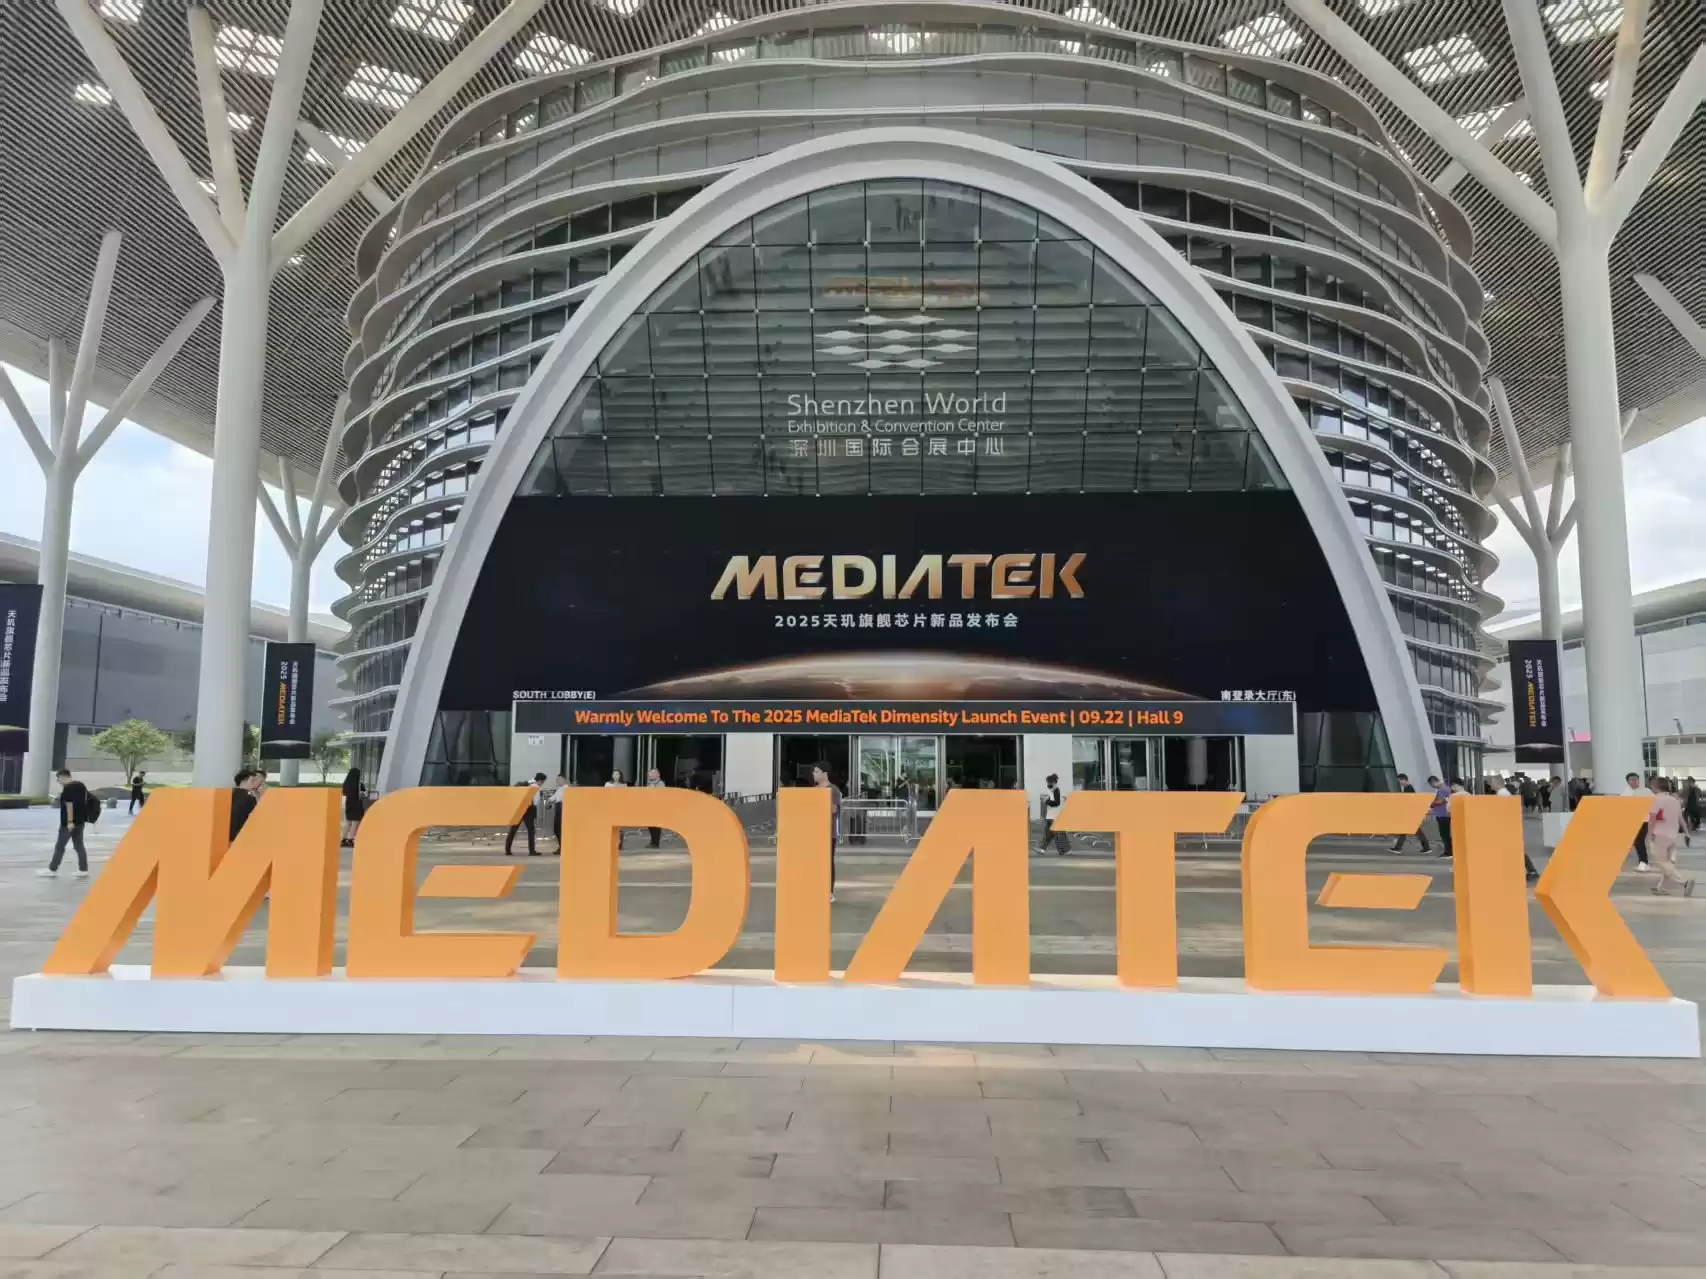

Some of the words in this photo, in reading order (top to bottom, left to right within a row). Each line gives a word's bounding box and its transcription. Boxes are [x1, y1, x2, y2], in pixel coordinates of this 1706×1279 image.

[787, 393, 914, 416] Shenzhen
[924, 391, 1007, 415] World
[787, 419, 857, 433] Exhibition
[860, 419, 870, 433] &
[874, 418, 955, 433] Convention
[957, 418, 1005, 432] Center
[788, 436, 1005, 457] 深圳国际会展中心
[710, 552, 1087, 601] MEDIATEK
[280, 660, 288, 680] 2025
[1524, 659, 1533, 679] 2025
[512, 690, 547, 700] SOUTH
[551, 690, 597, 701] LOBBY(E)
[575, 709, 634, 727] Warmly
[636, 709, 708, 724] Welcome
[711, 709, 729, 724] To
[731, 709, 761, 724] The
[763, 709, 803, 724] 2025
[805, 709, 878, 724] MediaTek
[880, 709, 958, 728] Dimensity
[962, 710, 1018, 724] Launch
[1021, 710, 1067, 724] Event
[1079, 710, 1125, 725] 09.22
[1137, 710, 1170, 725] Hall
[1172, 710, 1184, 725] 9
[41, 786, 1673, 1000] MEDIATEK
